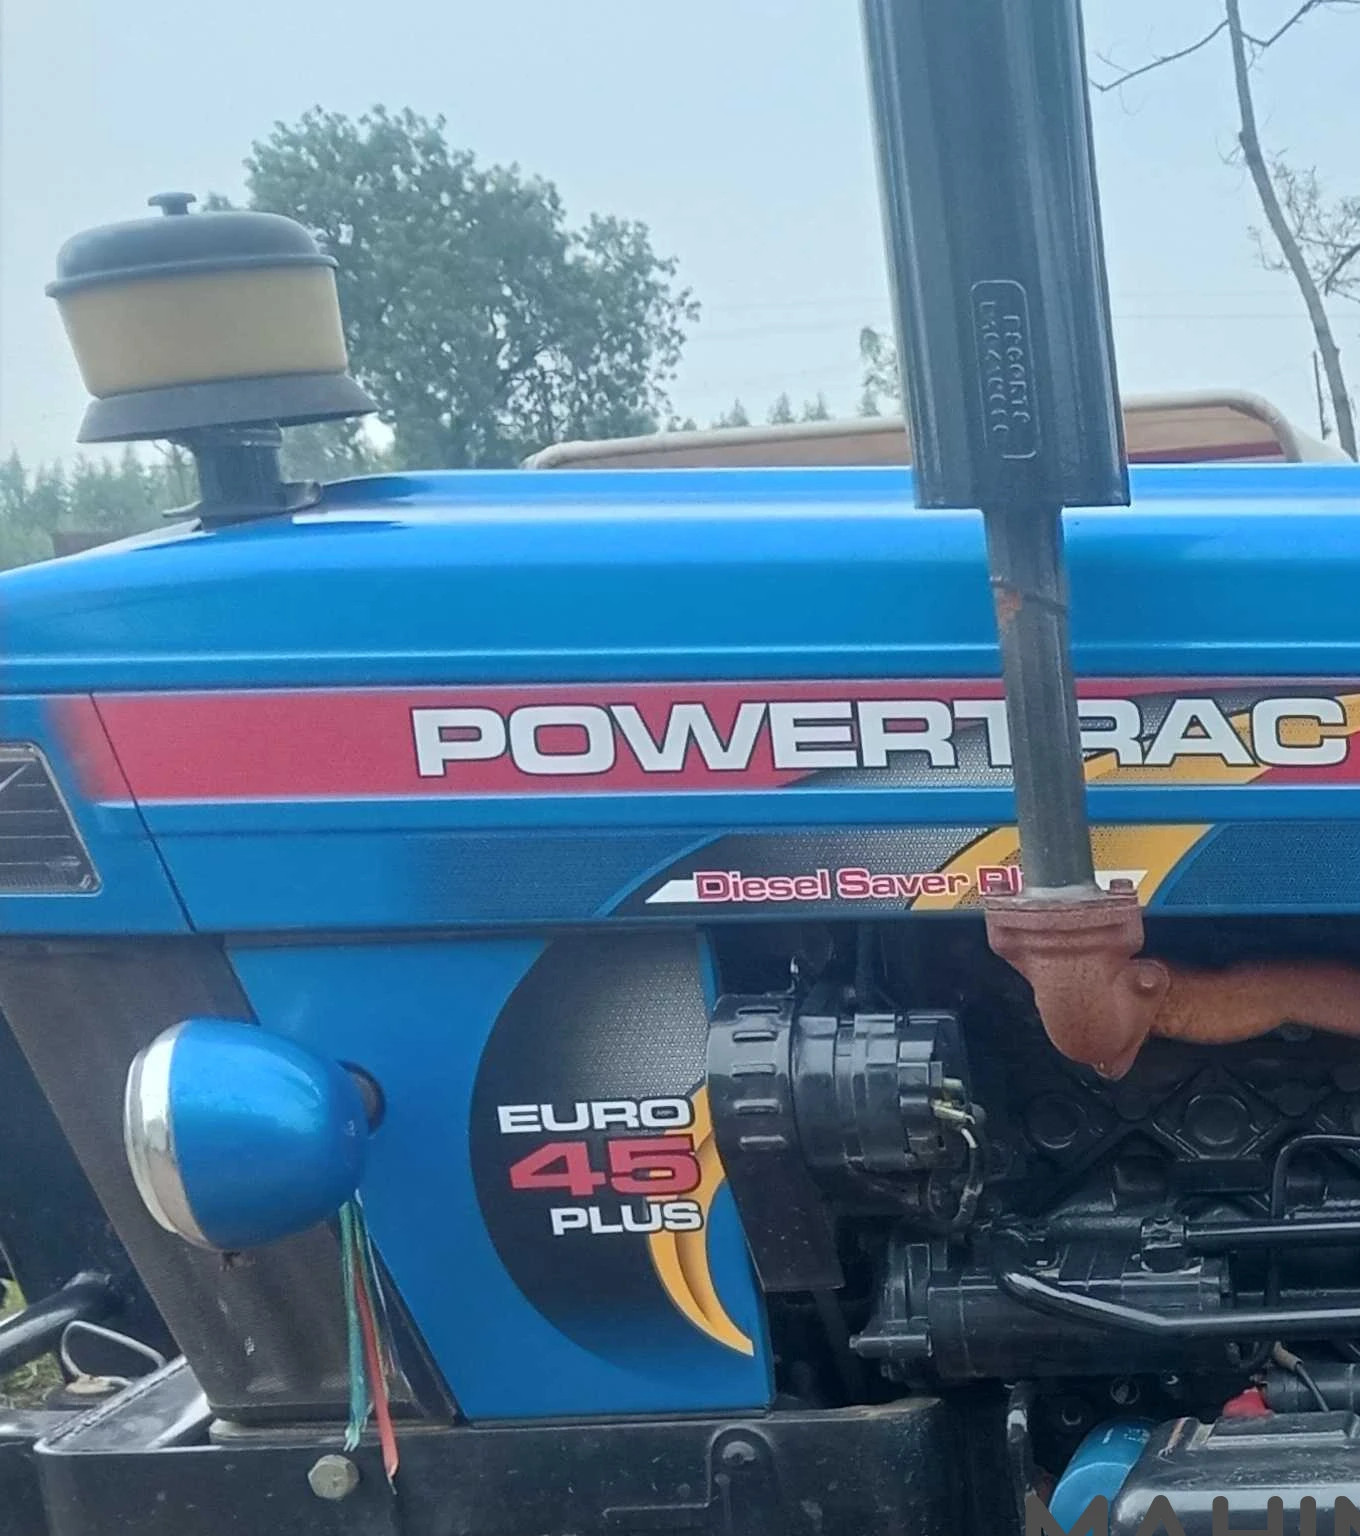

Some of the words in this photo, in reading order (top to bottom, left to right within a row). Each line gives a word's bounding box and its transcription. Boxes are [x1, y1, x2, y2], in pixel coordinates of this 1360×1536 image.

[692, 868, 830, 903] Diesel
[836, 867, 967, 898] Saver
[497, 1098, 695, 1135] EURO
[508, 1134, 702, 1197] 45
[550, 1201, 704, 1237] PLUS
